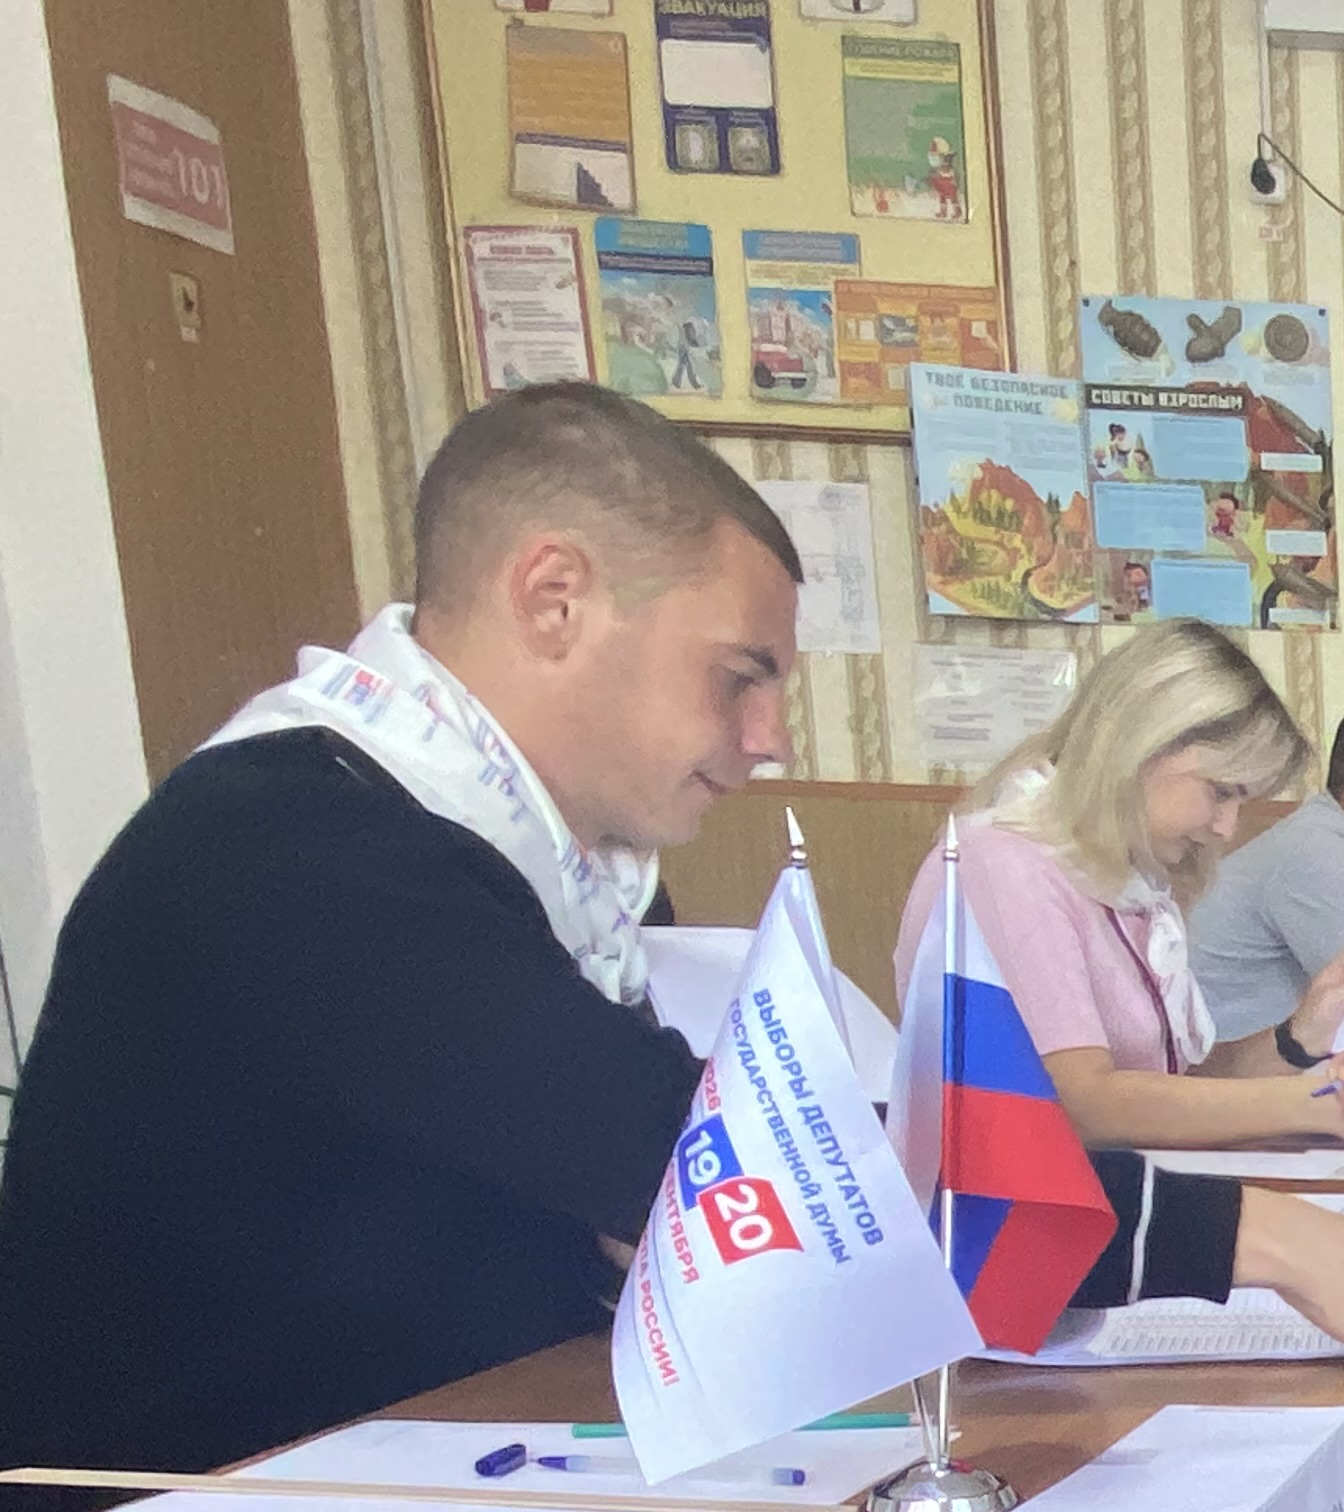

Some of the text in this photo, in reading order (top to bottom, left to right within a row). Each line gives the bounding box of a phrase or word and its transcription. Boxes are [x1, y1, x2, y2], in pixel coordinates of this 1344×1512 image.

[1091, 388, 1243, 410] СОВЕТЫ ВЗРОСЛЫМ
[728, 997, 852, 1265] ГОСУДАРСТВЕННОЙ ДУМЫ
[753, 988, 885, 1247] ВЫБОРЫ ДЕПУТАТОВ
[685, 1130, 773, 1251] 19 20
[640, 1279, 681, 1387] РОССИИ!
